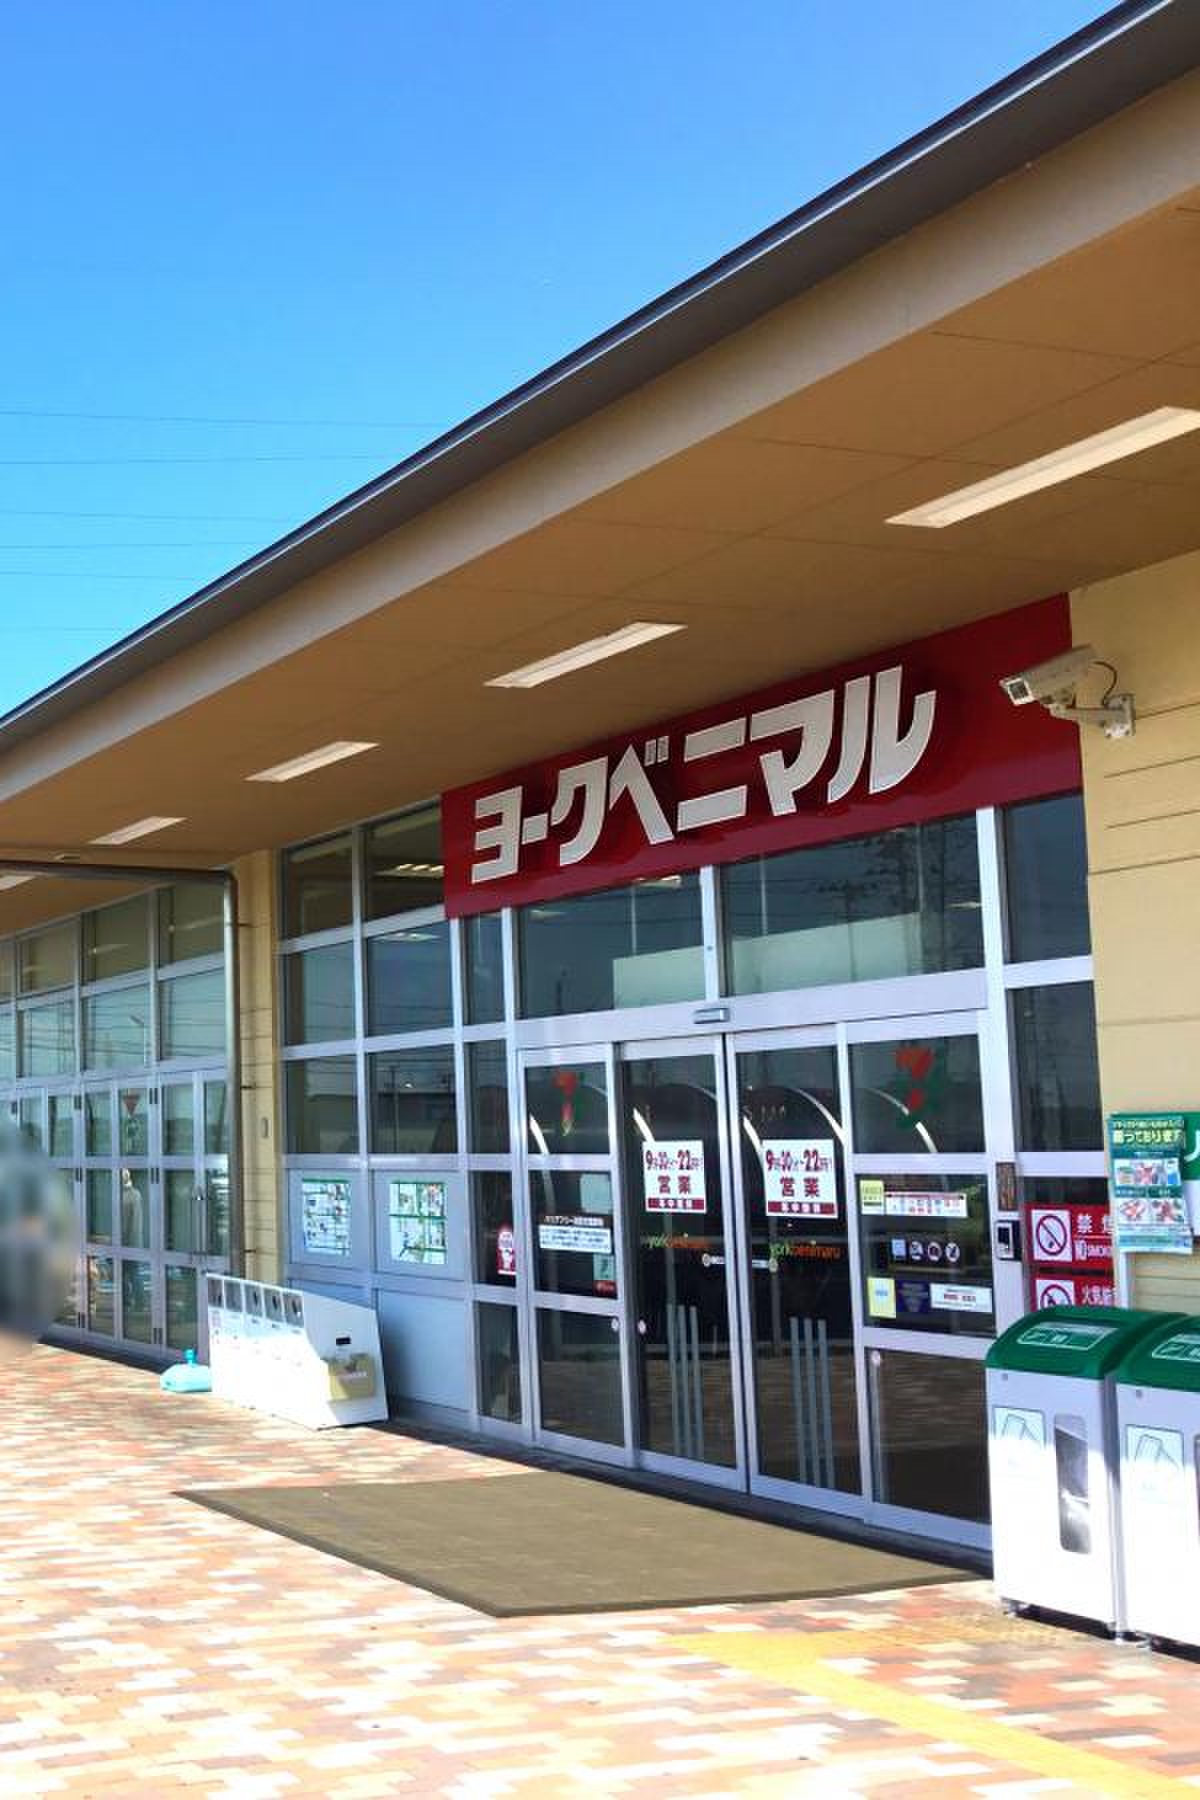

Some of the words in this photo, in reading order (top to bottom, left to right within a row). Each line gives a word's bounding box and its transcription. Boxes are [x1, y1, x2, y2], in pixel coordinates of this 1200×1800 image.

[471, 664, 937, 884] ヨークベニマル
[779, 1176, 820, 1198] 営業
